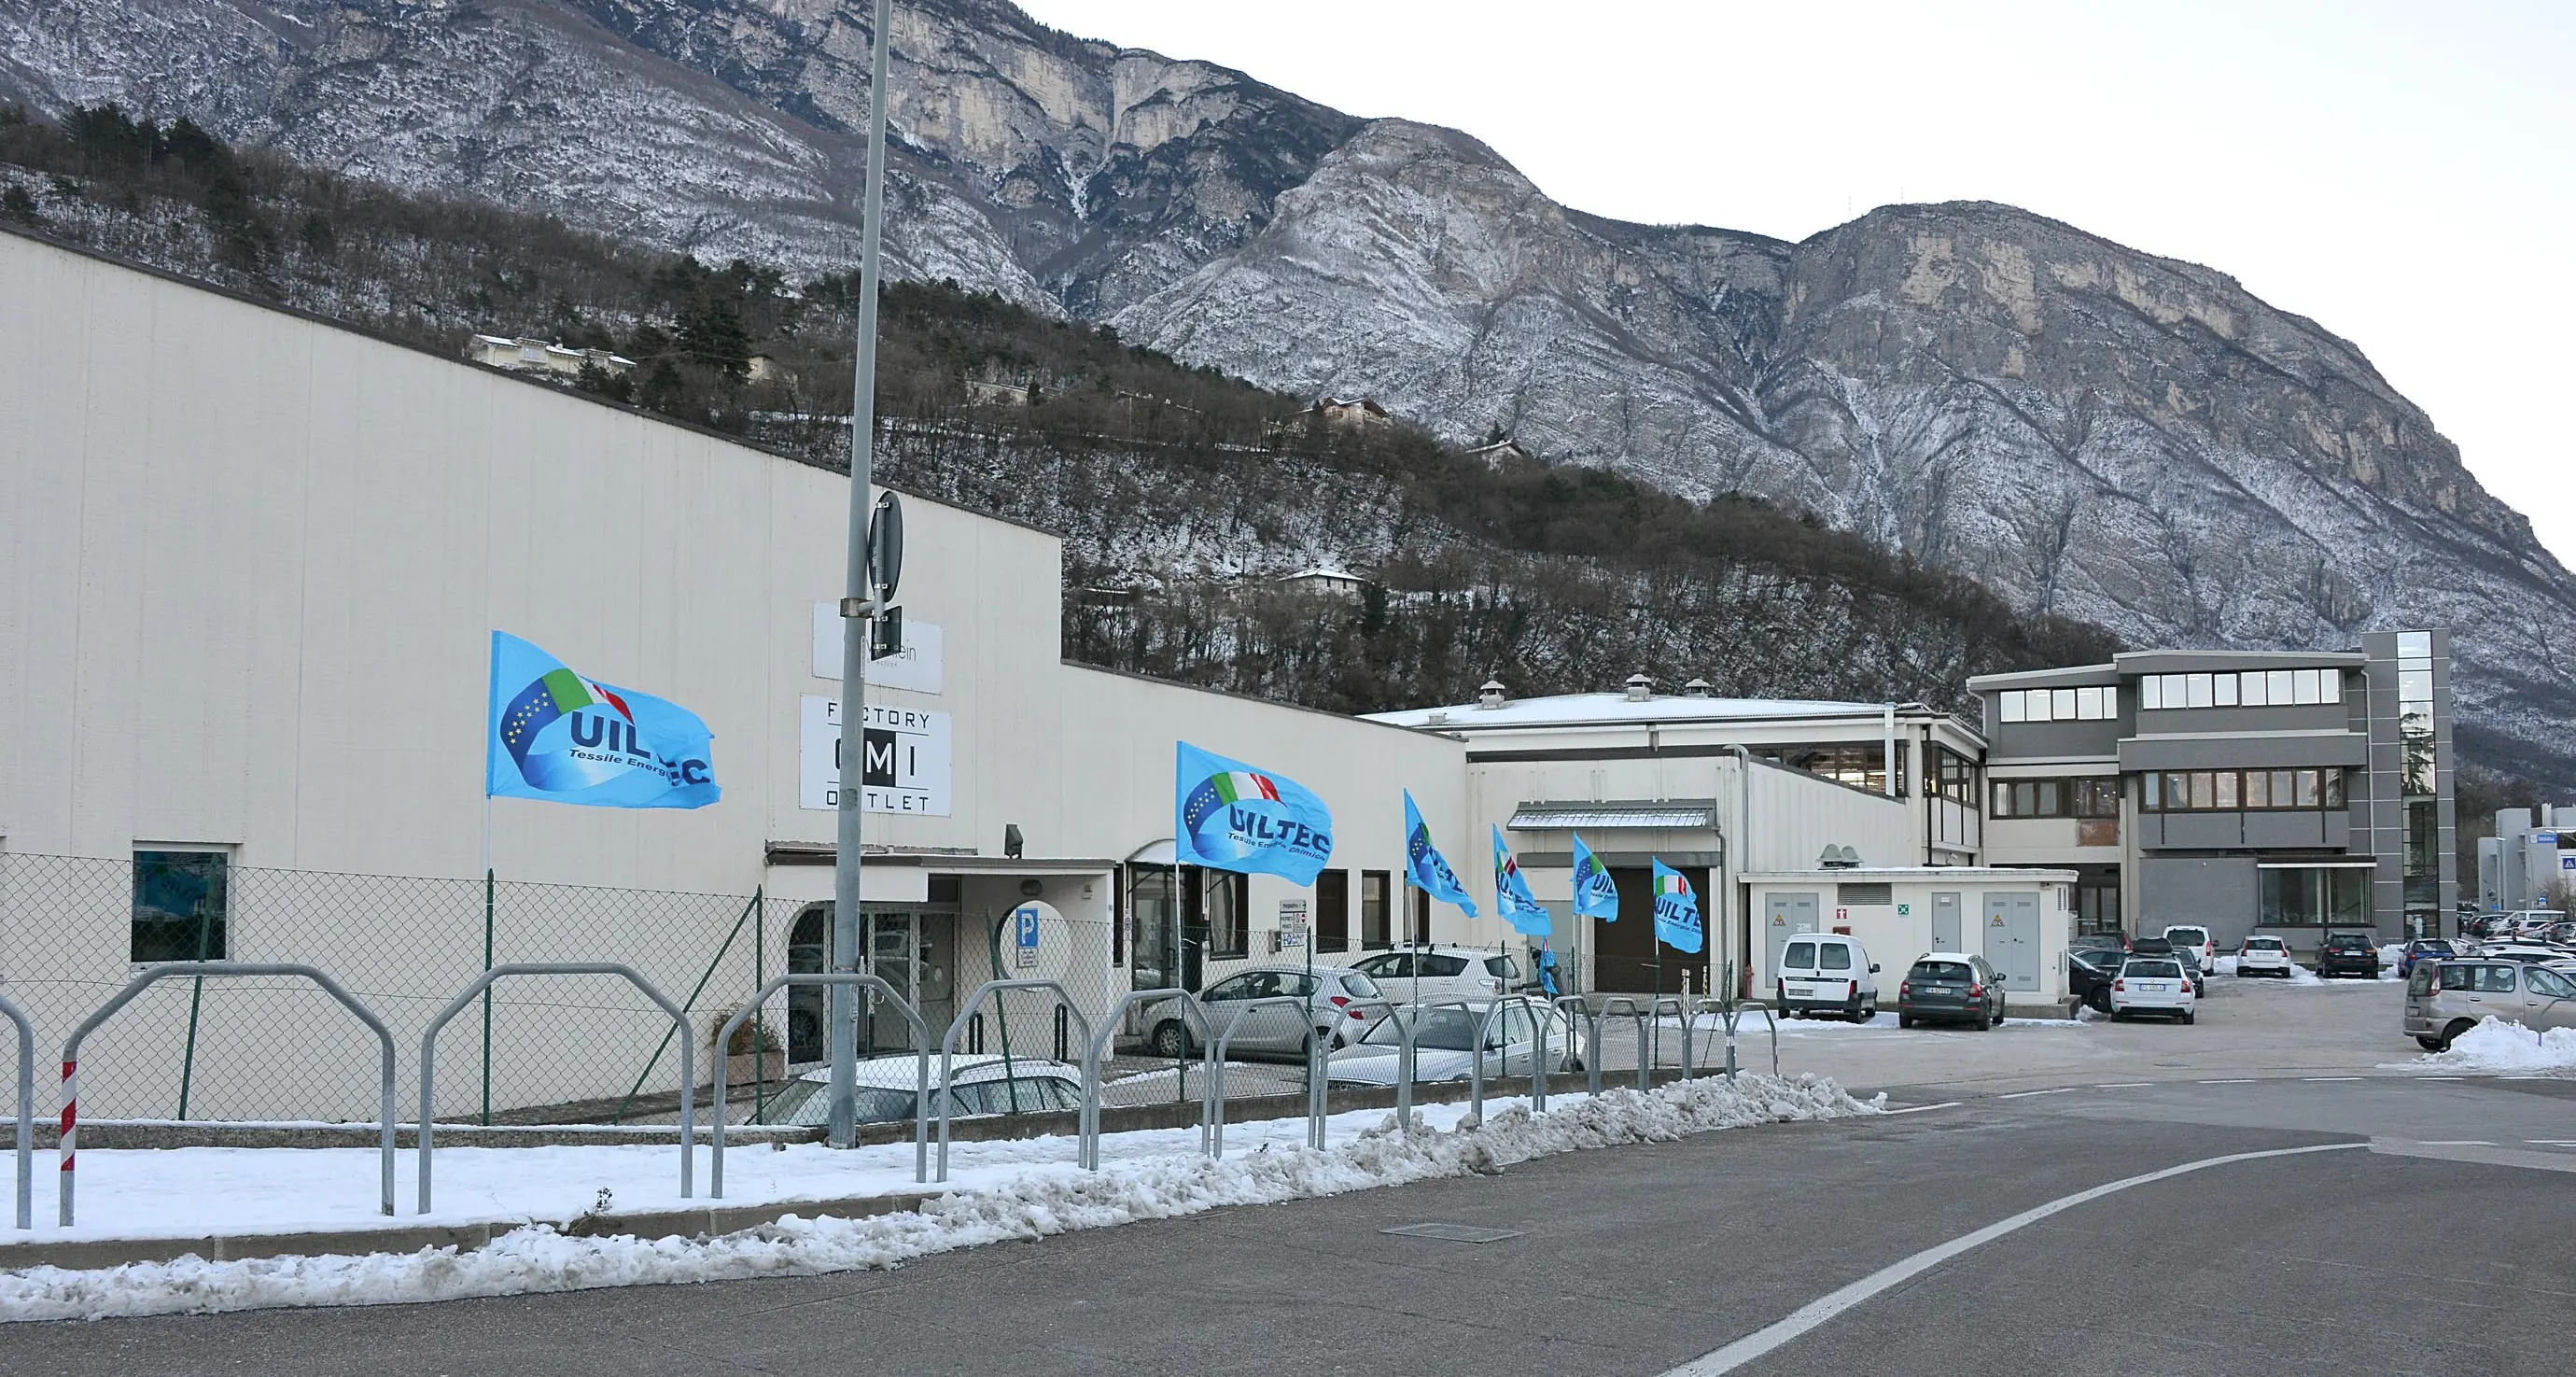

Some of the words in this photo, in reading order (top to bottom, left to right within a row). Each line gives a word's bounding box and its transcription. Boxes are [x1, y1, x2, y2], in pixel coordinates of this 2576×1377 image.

[828, 702, 930, 729] FCTORY
[569, 749, 623, 764] Tessile
[826, 790, 930, 812] OTLET
[1229, 803, 1330, 854] UILTEC
[1021, 912, 1035, 944] P
